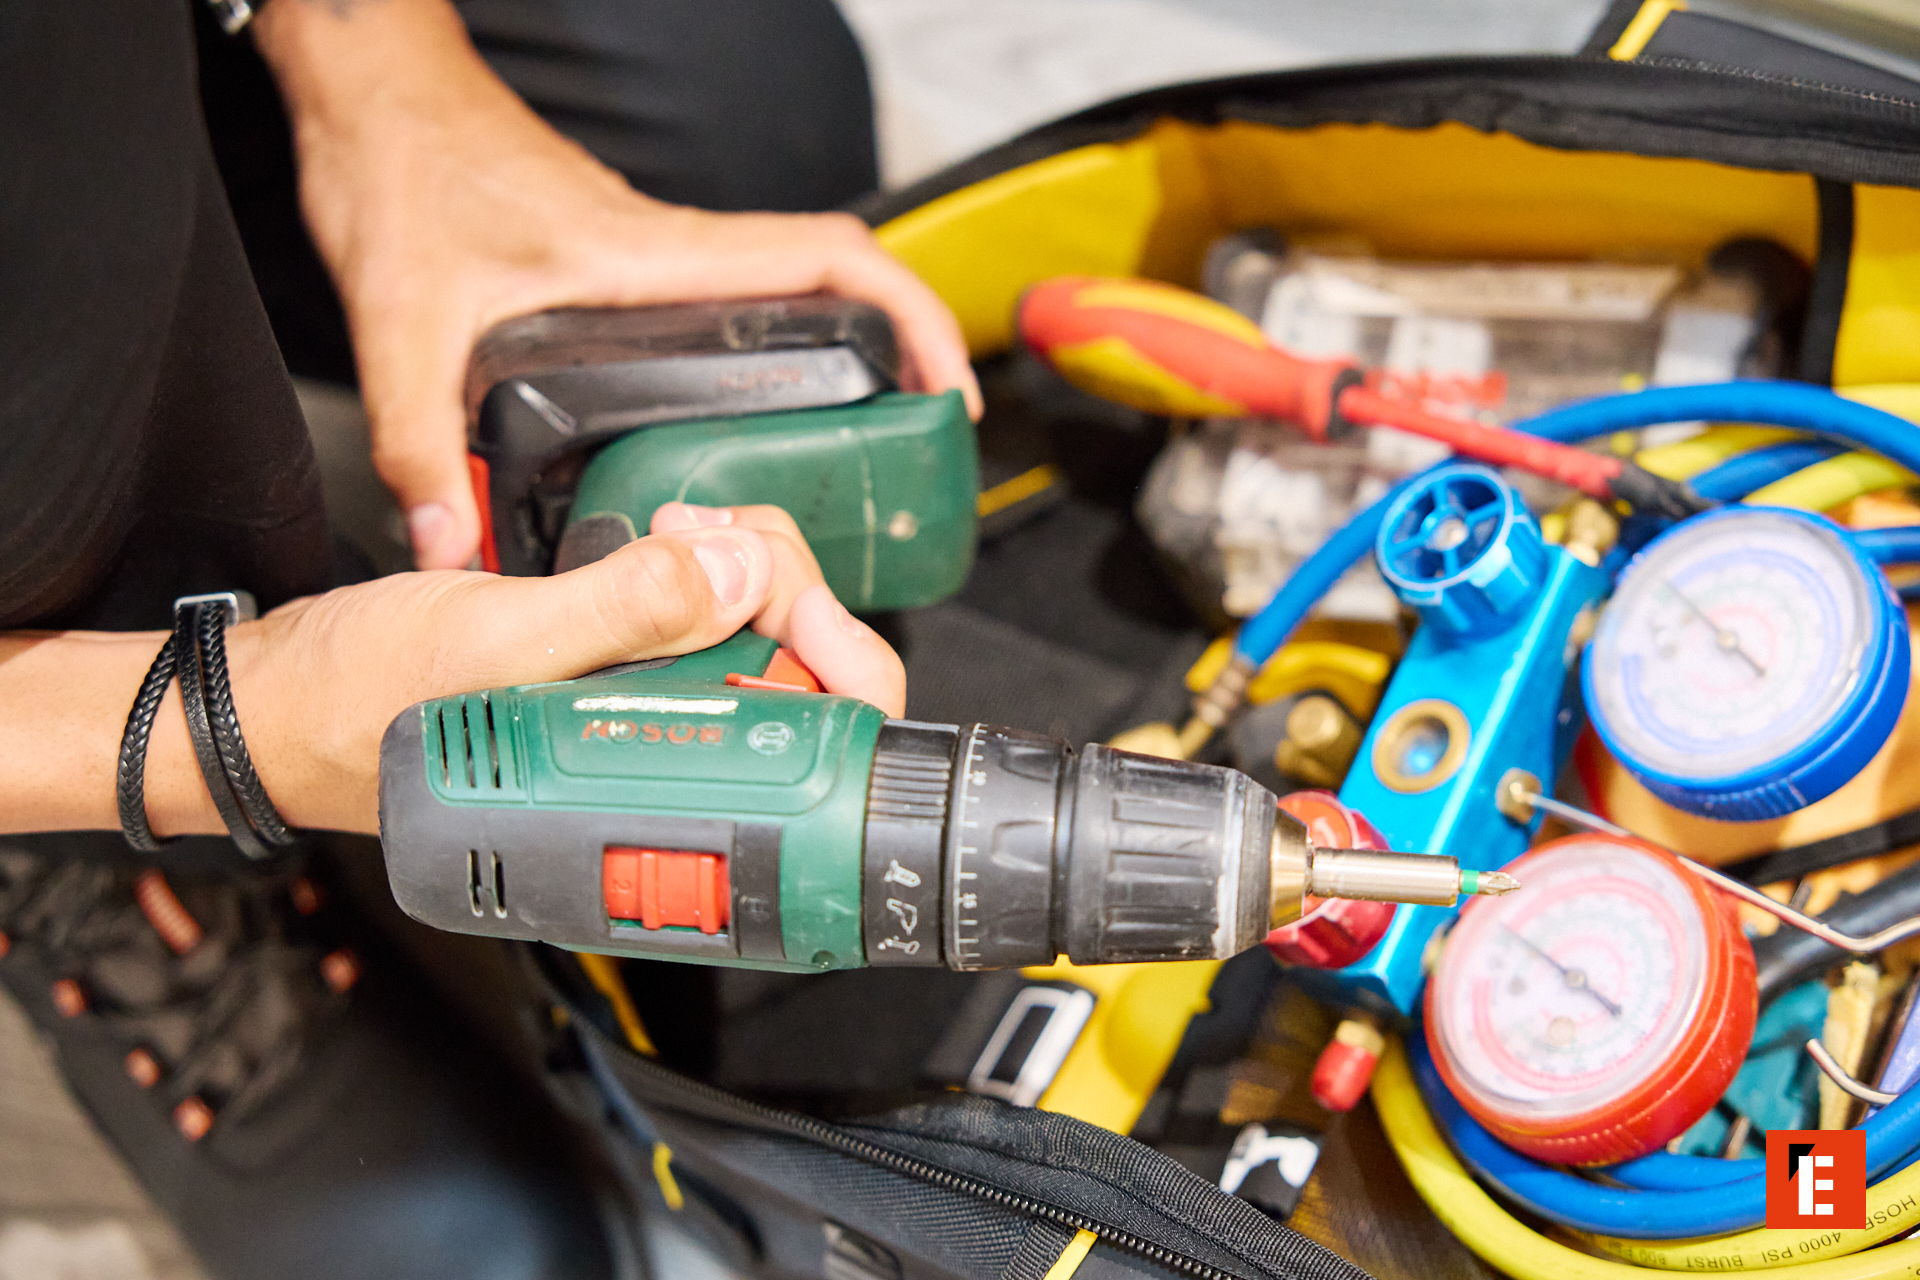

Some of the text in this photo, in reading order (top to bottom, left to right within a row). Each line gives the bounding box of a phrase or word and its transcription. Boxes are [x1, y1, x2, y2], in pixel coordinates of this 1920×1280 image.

[579, 720, 724, 745] BOSCH
[1799, 1232, 1842, 1254] 4000
[1686, 1254, 1744, 1268] BURST
[1761, 1246, 1794, 1263] PSI
